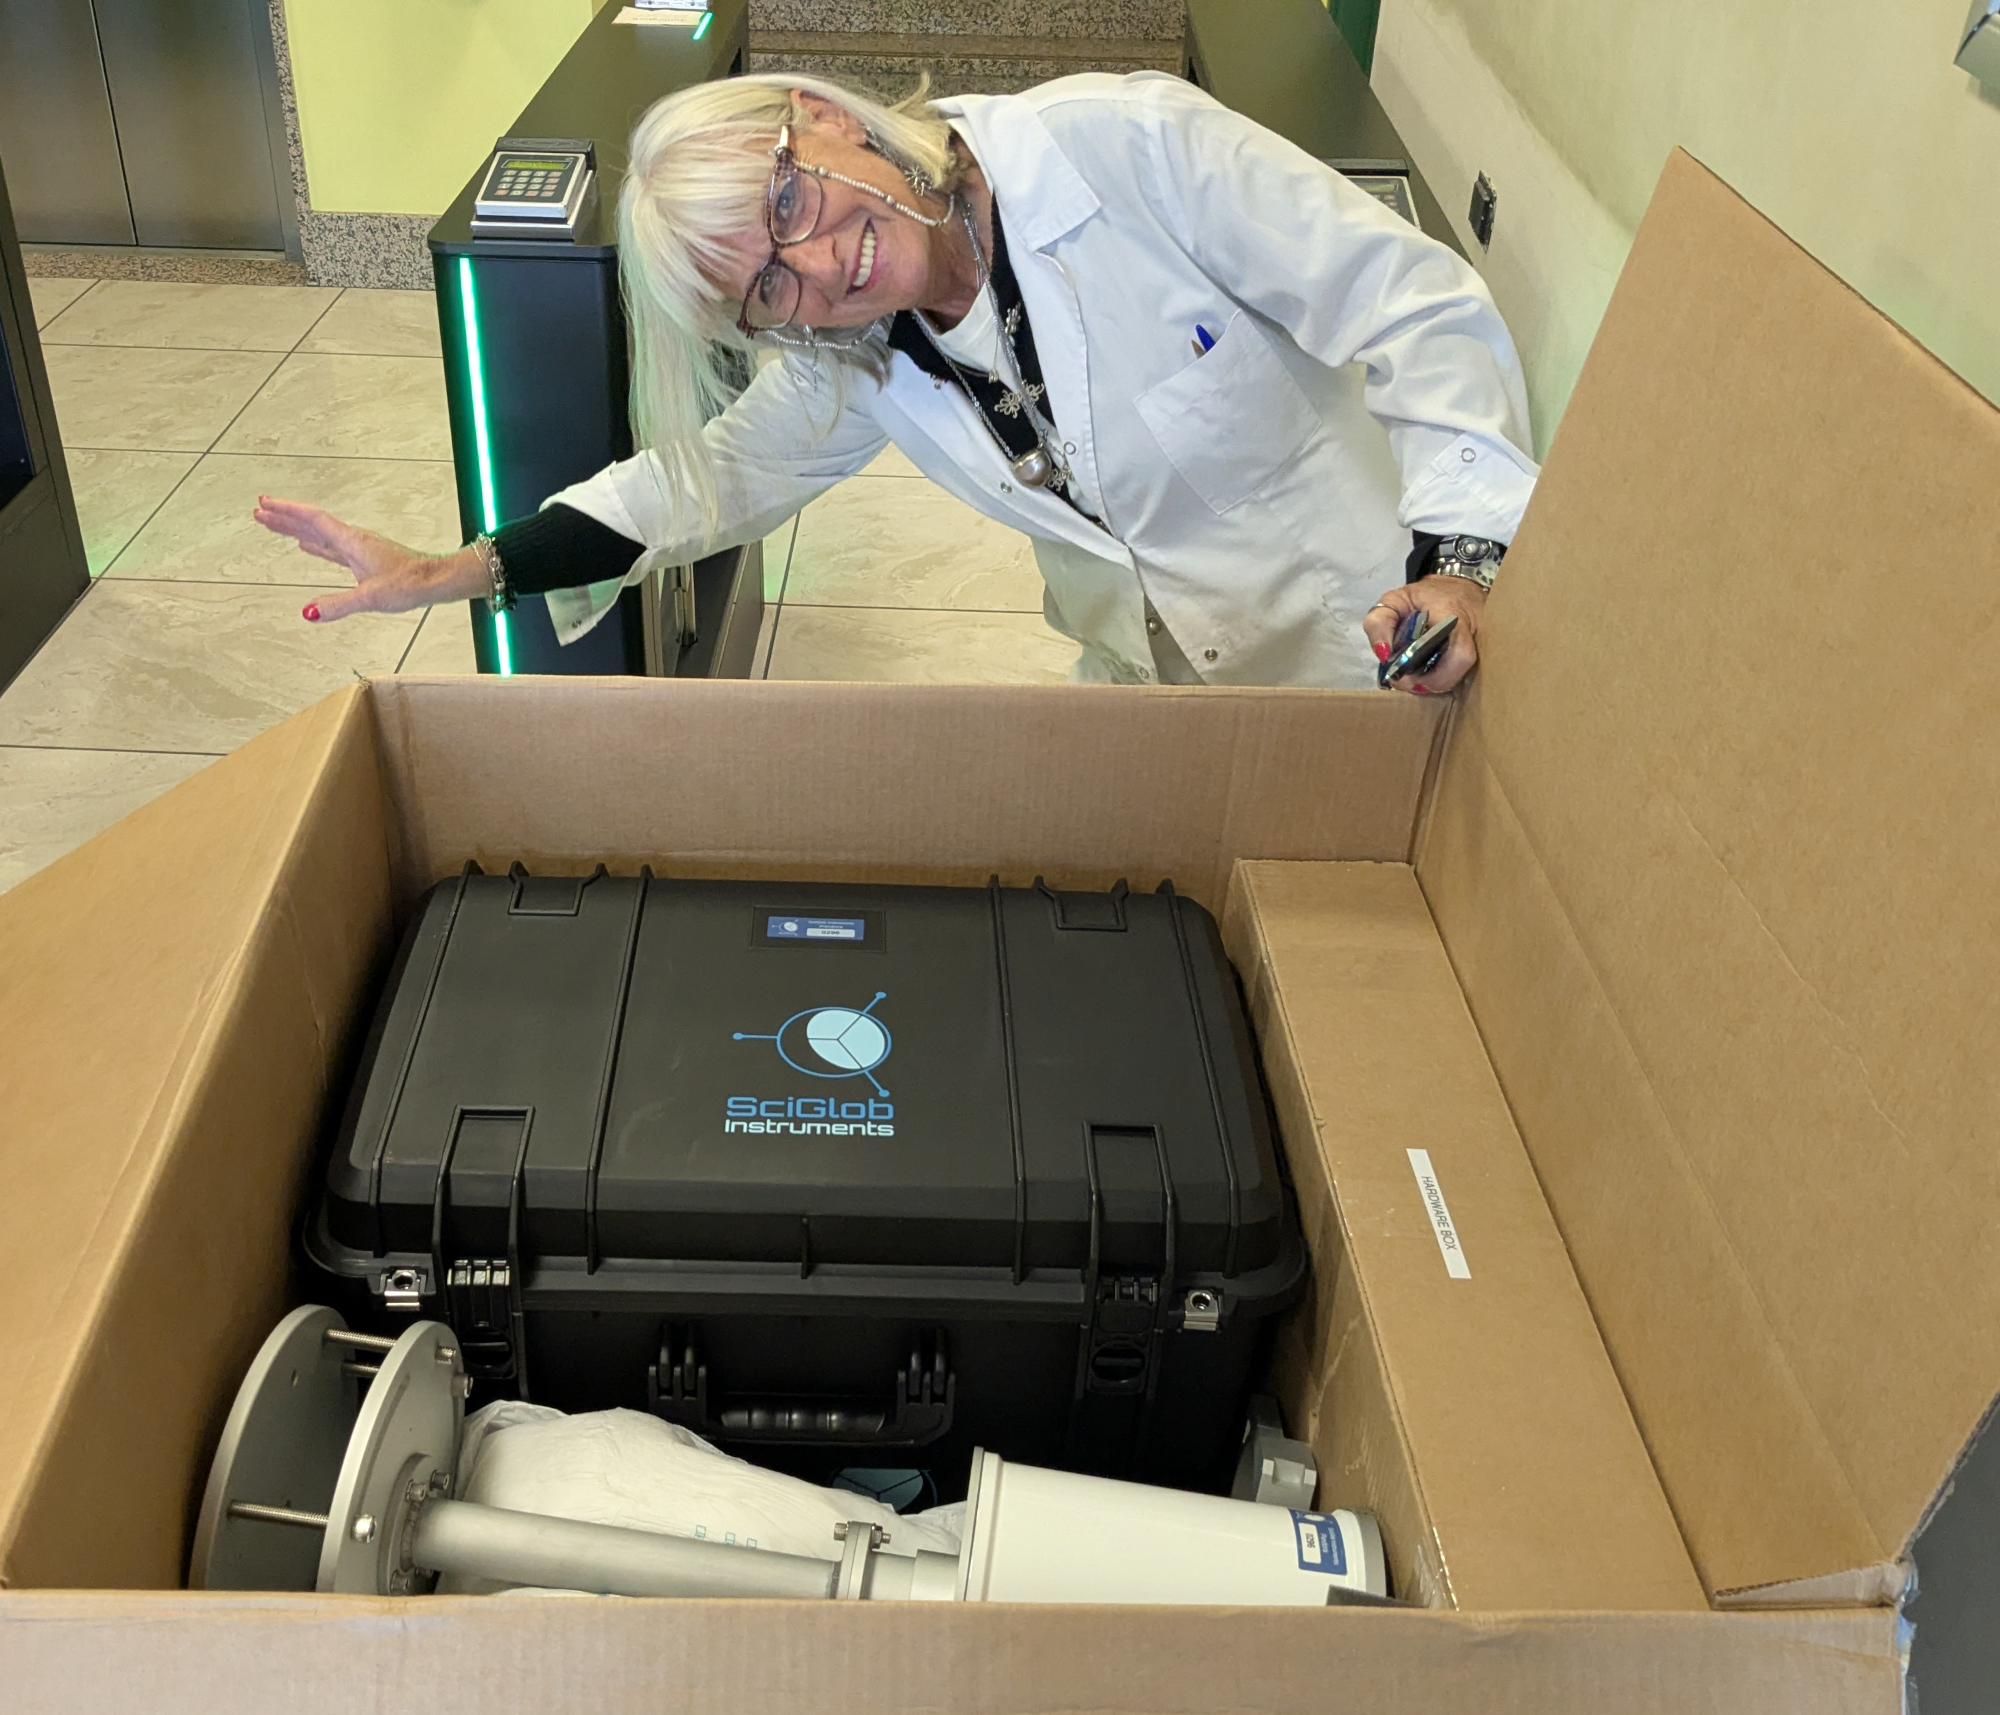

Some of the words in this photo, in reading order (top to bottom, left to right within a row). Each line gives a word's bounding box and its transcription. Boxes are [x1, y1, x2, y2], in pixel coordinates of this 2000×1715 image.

[726, 1096, 894, 1120] SciGlob
[724, 1118, 895, 1136] Instruments
[1421, 1175, 1450, 1229] HARDWARE
[1440, 1229, 1458, 1251] BOX
[1305, 1533, 1316, 1549] 0296
